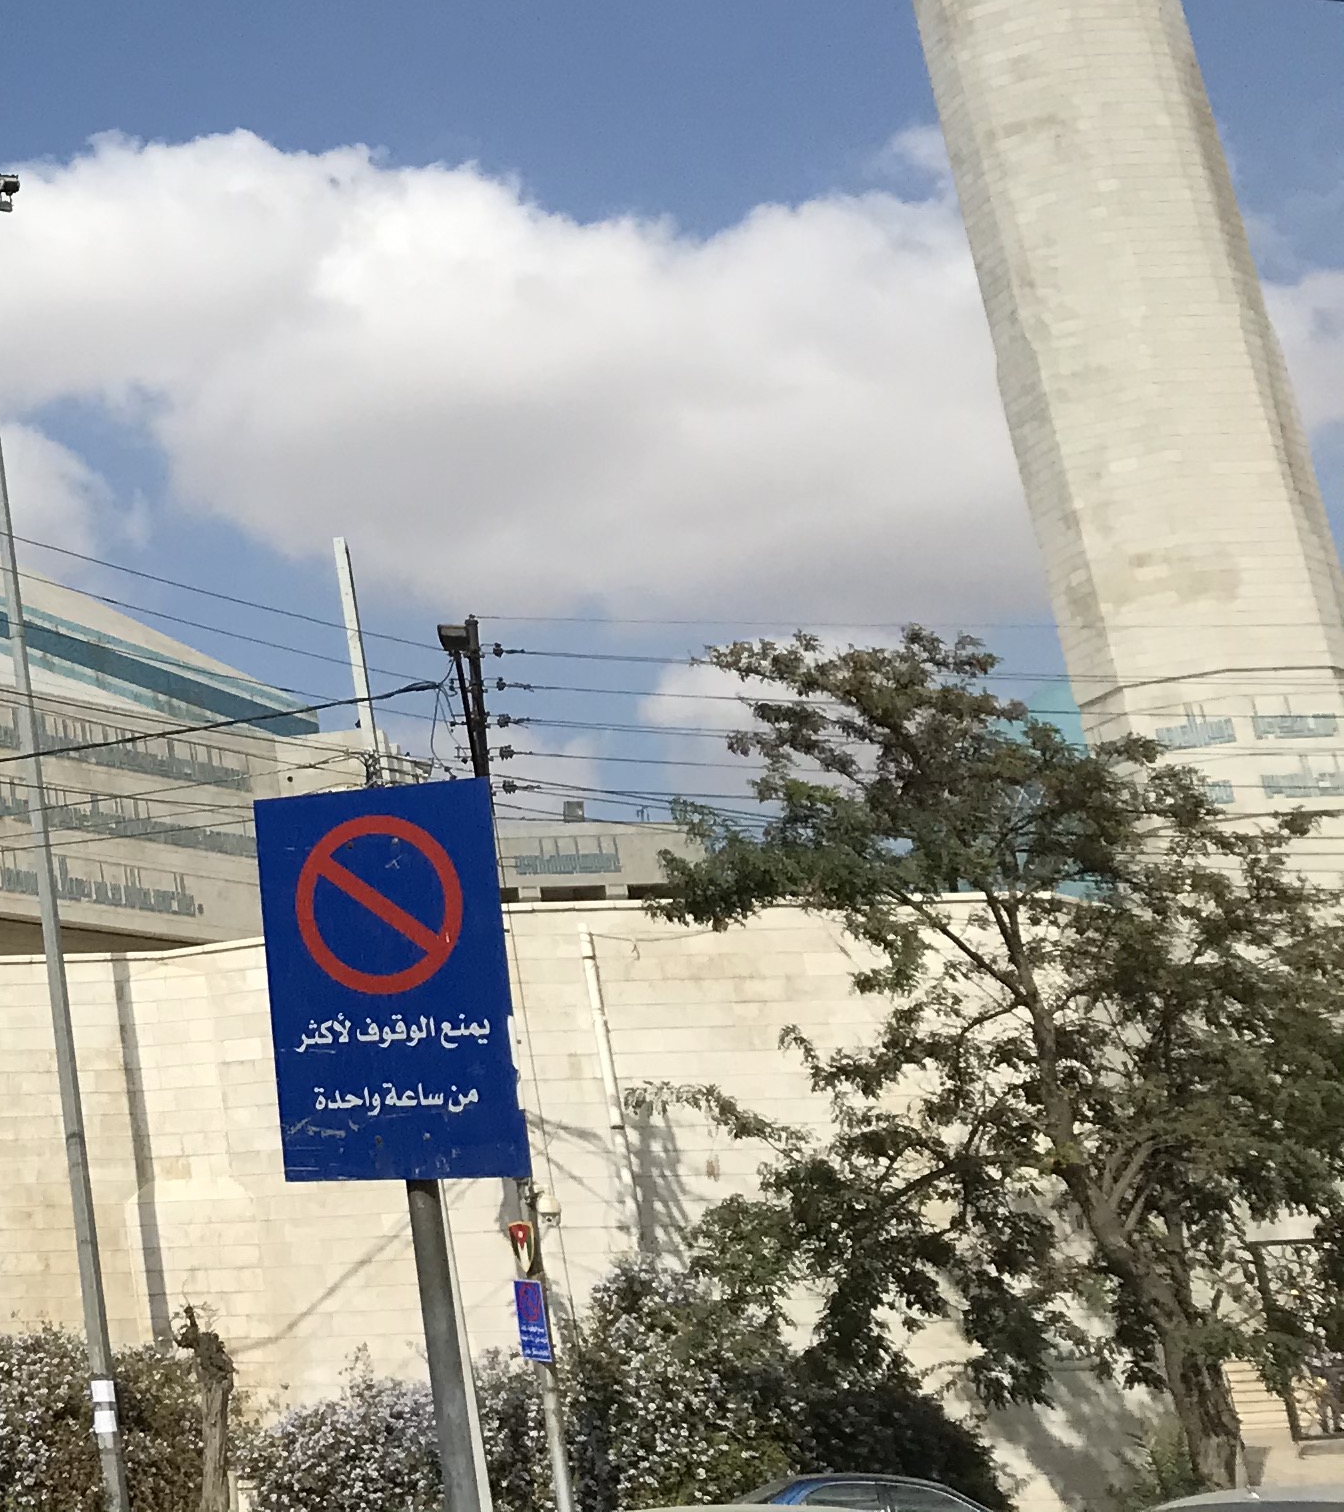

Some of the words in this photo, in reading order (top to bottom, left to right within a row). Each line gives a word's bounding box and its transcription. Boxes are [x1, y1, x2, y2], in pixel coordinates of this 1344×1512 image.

[294, 1012, 351, 1052] لأكثر
[356, 1014, 435, 1048] الوقوف
[440, 1013, 490, 1049] يمنع
[313, 1086, 381, 1116] واحدة
[382, 1082, 444, 1107] ساعة
[448, 1085, 479, 1113] من
